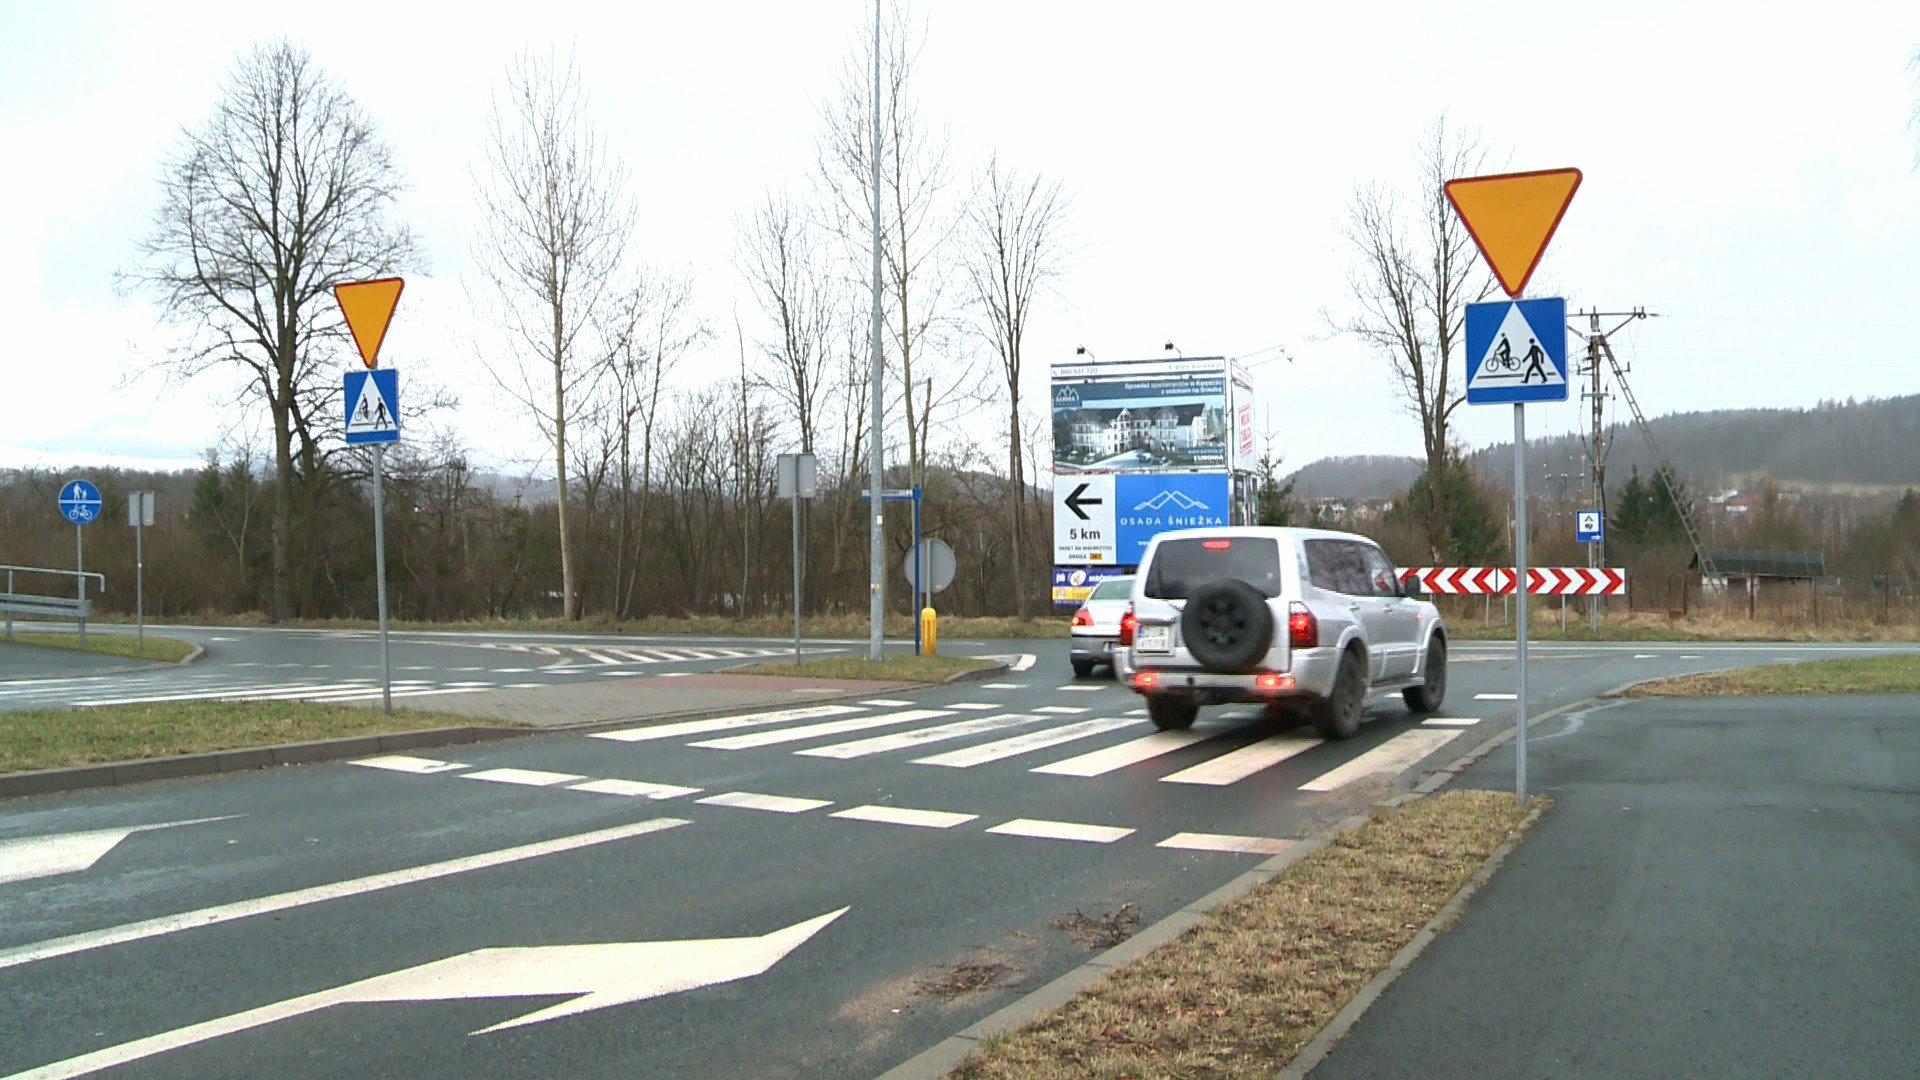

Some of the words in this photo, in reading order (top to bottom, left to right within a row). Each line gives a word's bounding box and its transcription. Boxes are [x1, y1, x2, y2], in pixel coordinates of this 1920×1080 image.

[1120, 517, 1161, 526] OSADA
[1168, 515, 1222, 526] ŚNIEŻKA
[1069, 528, 1077, 540] 5
[1080, 528, 1101, 540] km
